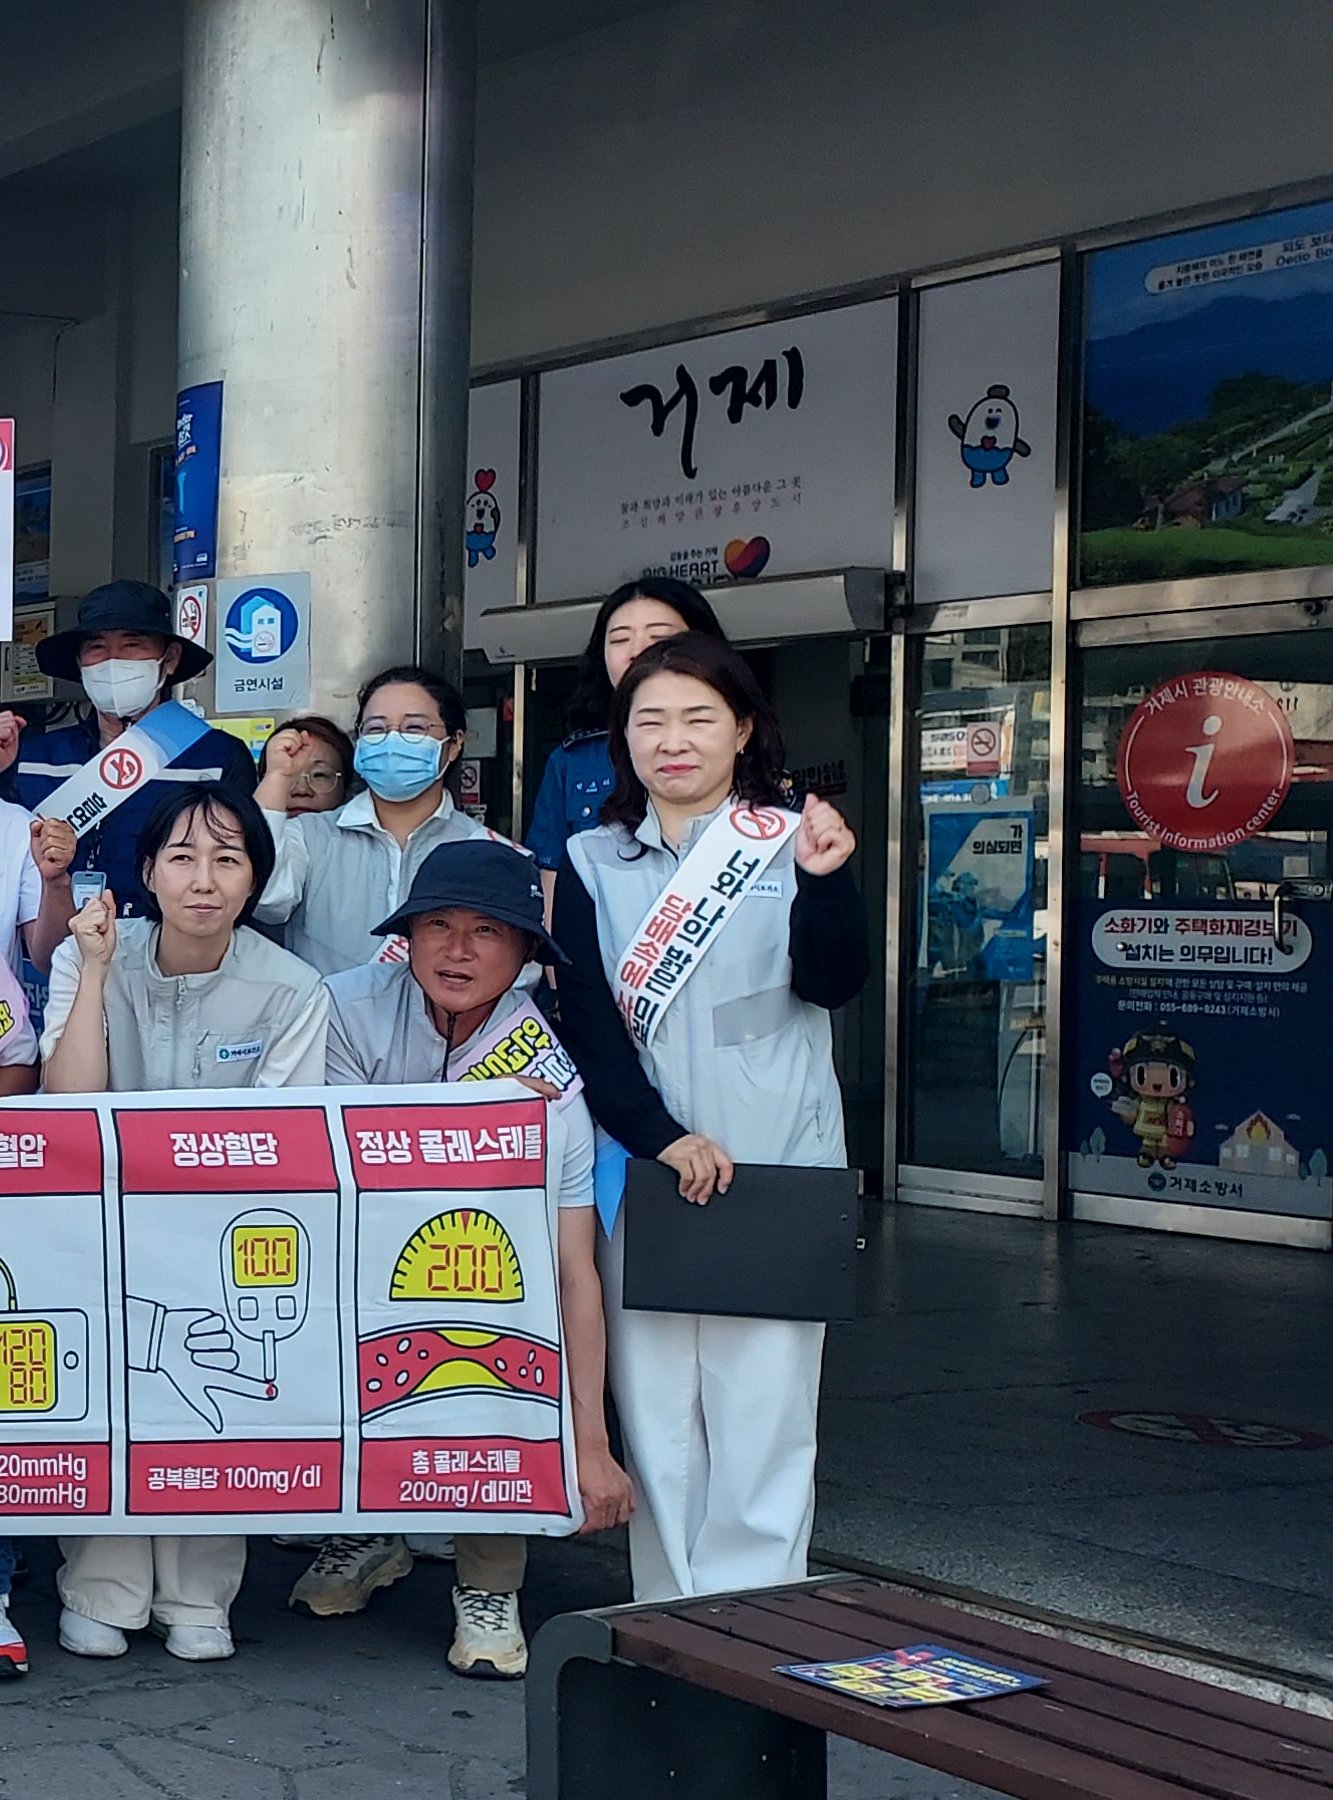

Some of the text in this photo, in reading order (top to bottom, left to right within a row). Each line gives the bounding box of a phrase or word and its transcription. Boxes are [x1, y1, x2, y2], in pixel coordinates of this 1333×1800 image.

[620, 346, 804, 479] 거제
[670, 560, 718, 577] HEART
[234, 676, 283, 693] 금연시설
[1143, 676, 1265, 716] 거제시 관광안내소
[1126, 790, 1160, 835] Tourist
[1246, 788, 1281, 831] center
[973, 840, 1023, 856] 의심되면
[1010, 825, 1023, 839] 가
[709, 849, 762, 901] 너와
[620, 893, 692, 990] 담배속에
[677, 896, 727, 949] 나의
[1105, 918, 1298, 938] 소화기와 주택화재경보기
[644, 945, 694, 998] 밝은
[1124, 944, 1273, 965] 설치는 의무입니다!
[169, 1130, 280, 1169] 정상혈당
[356, 1123, 543, 1165] 정상 콜레스테롤
[1169, 1176, 1244, 1196] 거제소방서
[236, 1236, 292, 1279] 100
[427, 1244, 503, 1293] 200
[8, 1366, 48, 1405] 80
[147, 1464, 322, 1493] 공복혈당 100mg/dl
[410, 1448, 522, 1475] 총 콜레스테롤
